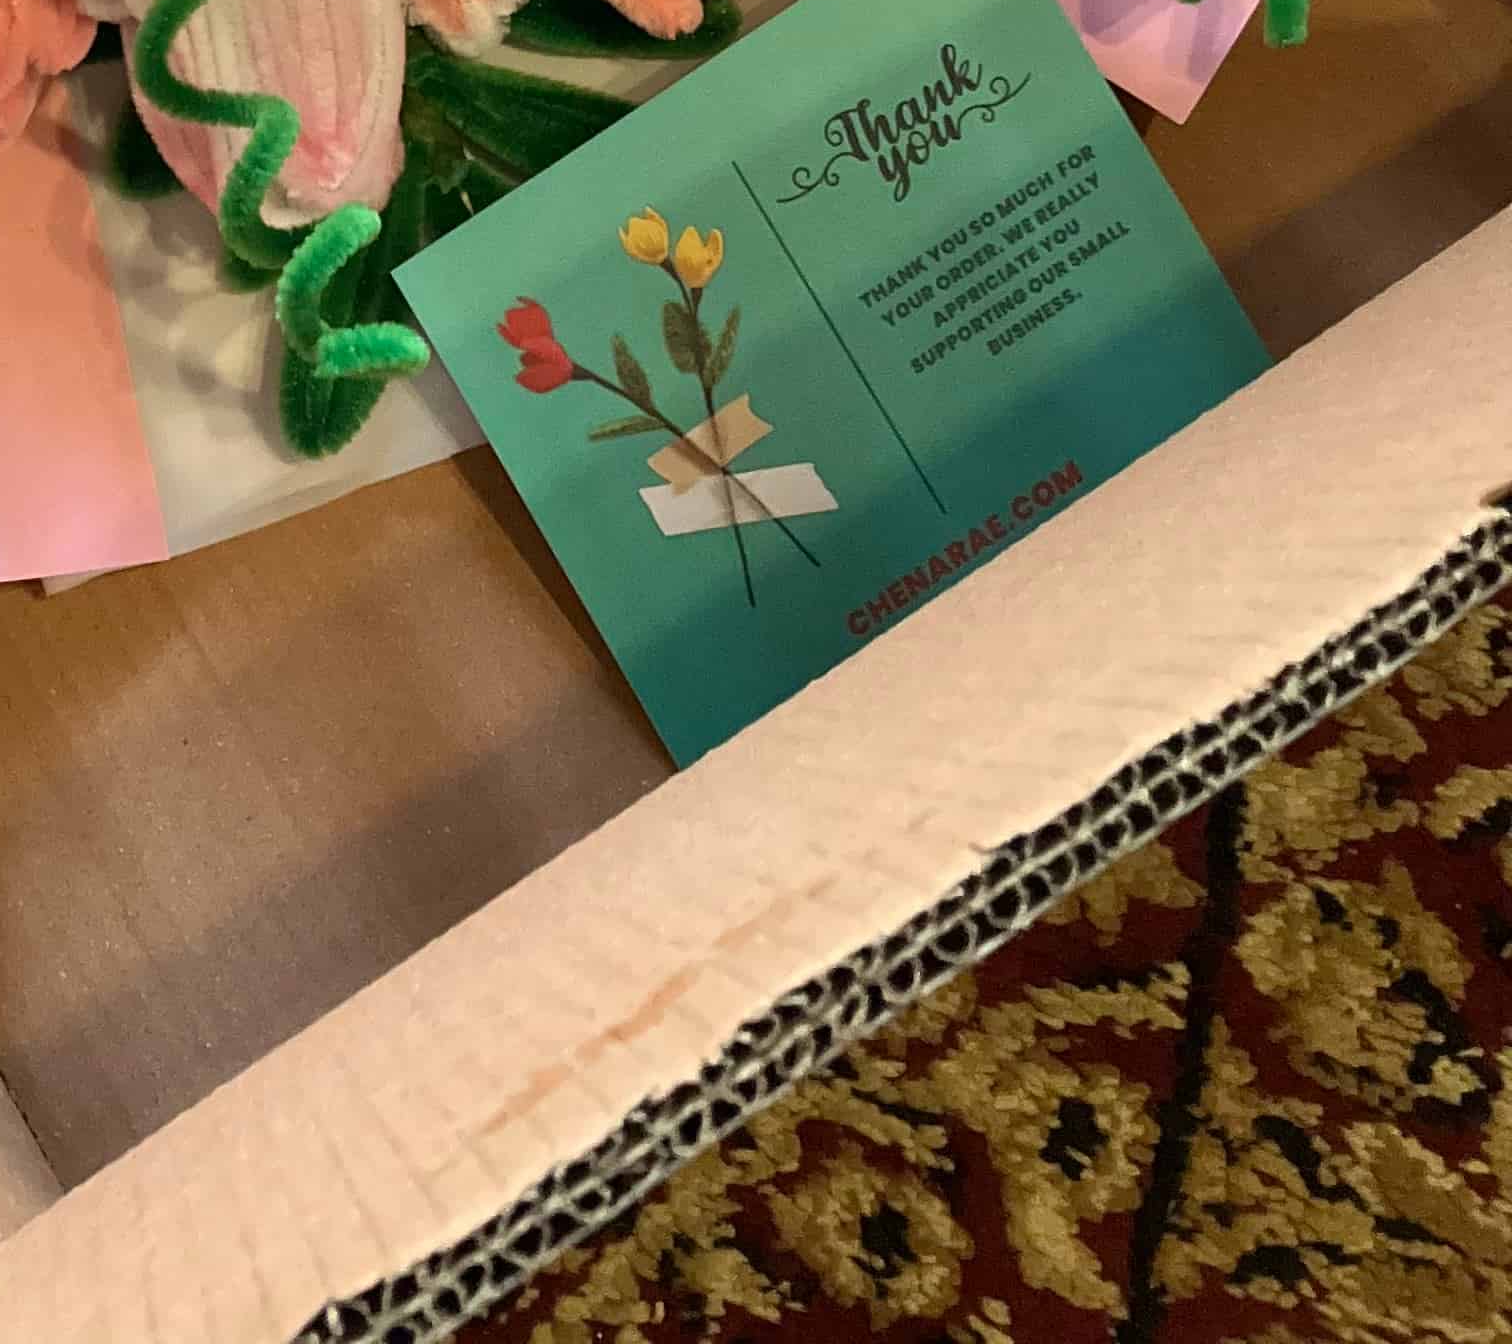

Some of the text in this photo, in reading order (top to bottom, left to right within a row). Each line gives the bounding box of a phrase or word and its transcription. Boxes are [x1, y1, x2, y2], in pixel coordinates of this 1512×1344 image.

[824, 44, 982, 162] Thank
[877, 114, 962, 202] you
[858, 144, 1097, 309] THANK YOU SO MUCH FOR
[881, 172, 1101, 328] YOUR ORDER. WE REALLY
[932, 219, 1081, 328] APPRICIATE YOU
[910, 220, 1131, 374] SUPPORTING OUR SMALL
[986, 287, 1084, 356] BUSINESS.
[848, 459, 1083, 635] CHENARAE.COM
